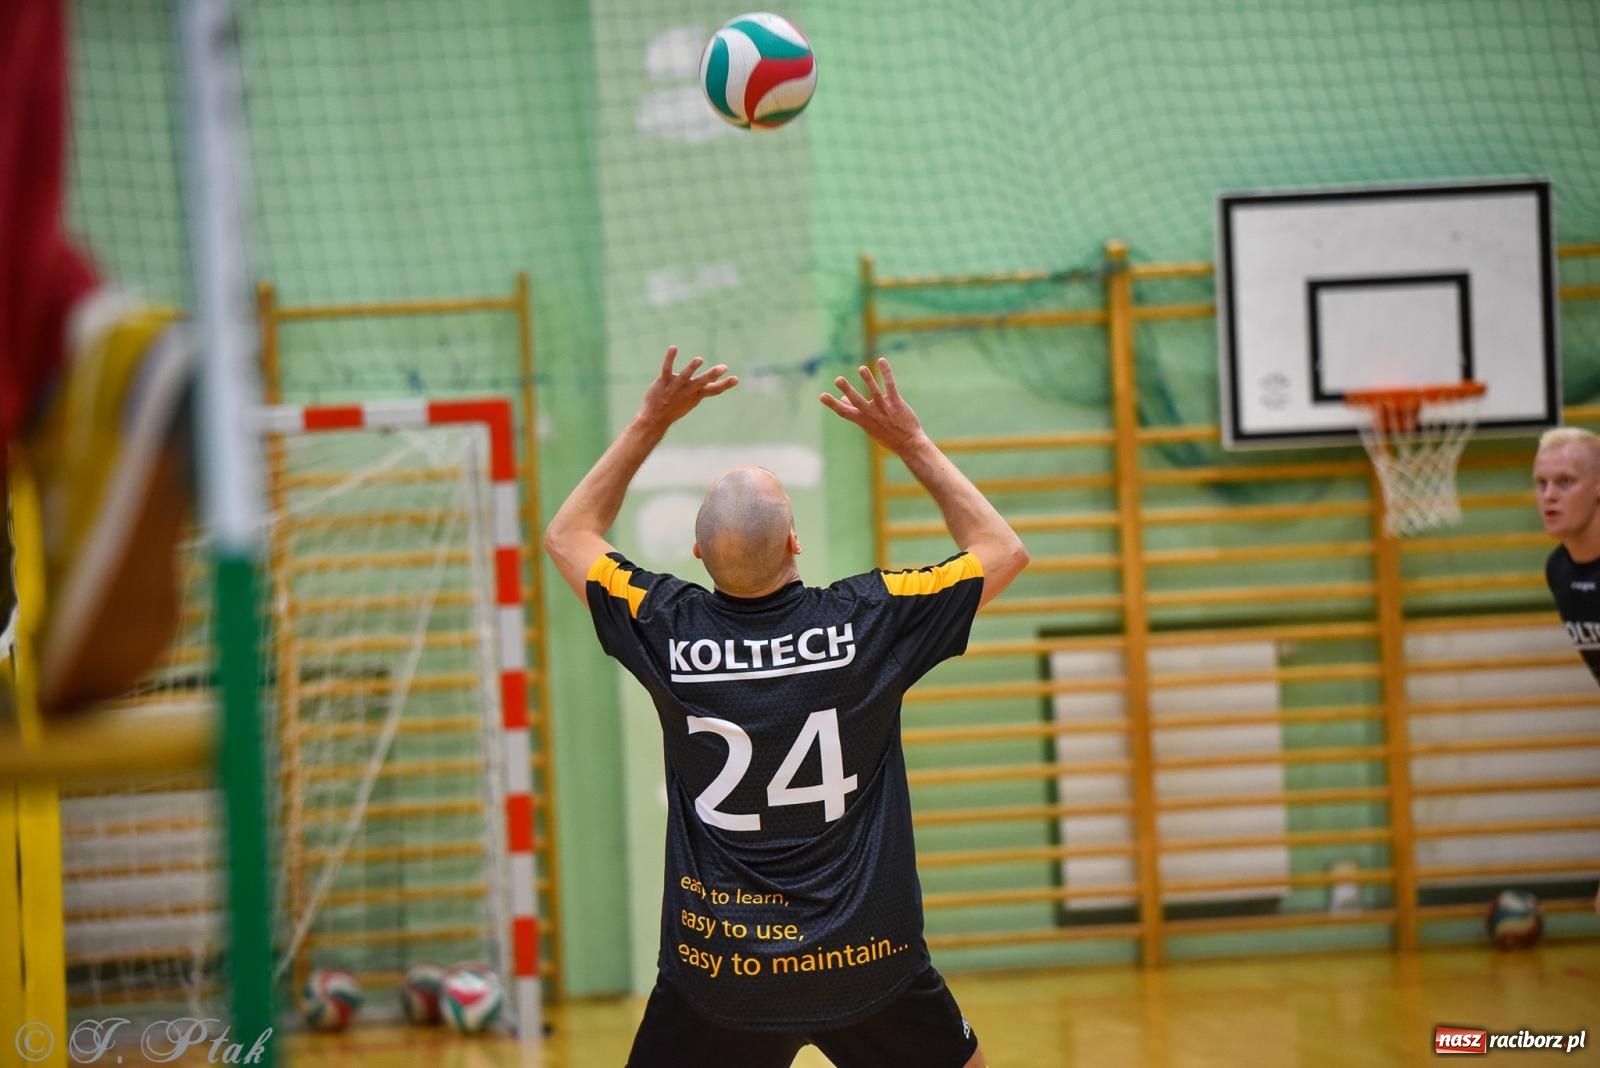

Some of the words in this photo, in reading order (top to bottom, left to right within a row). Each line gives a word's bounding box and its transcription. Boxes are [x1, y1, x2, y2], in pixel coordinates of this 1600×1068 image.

[669, 623, 855, 673] KOLTECH
[687, 708, 858, 831] 24
[711, 889, 730, 905] to
[736, 888, 790, 907] learn,
[681, 909, 716, 939] easy
[722, 920, 748, 938] to
[756, 924, 805, 941] use,
[678, 943, 722, 978] easy
[731, 953, 761, 976] to
[772, 936, 909, 974] maintain...
